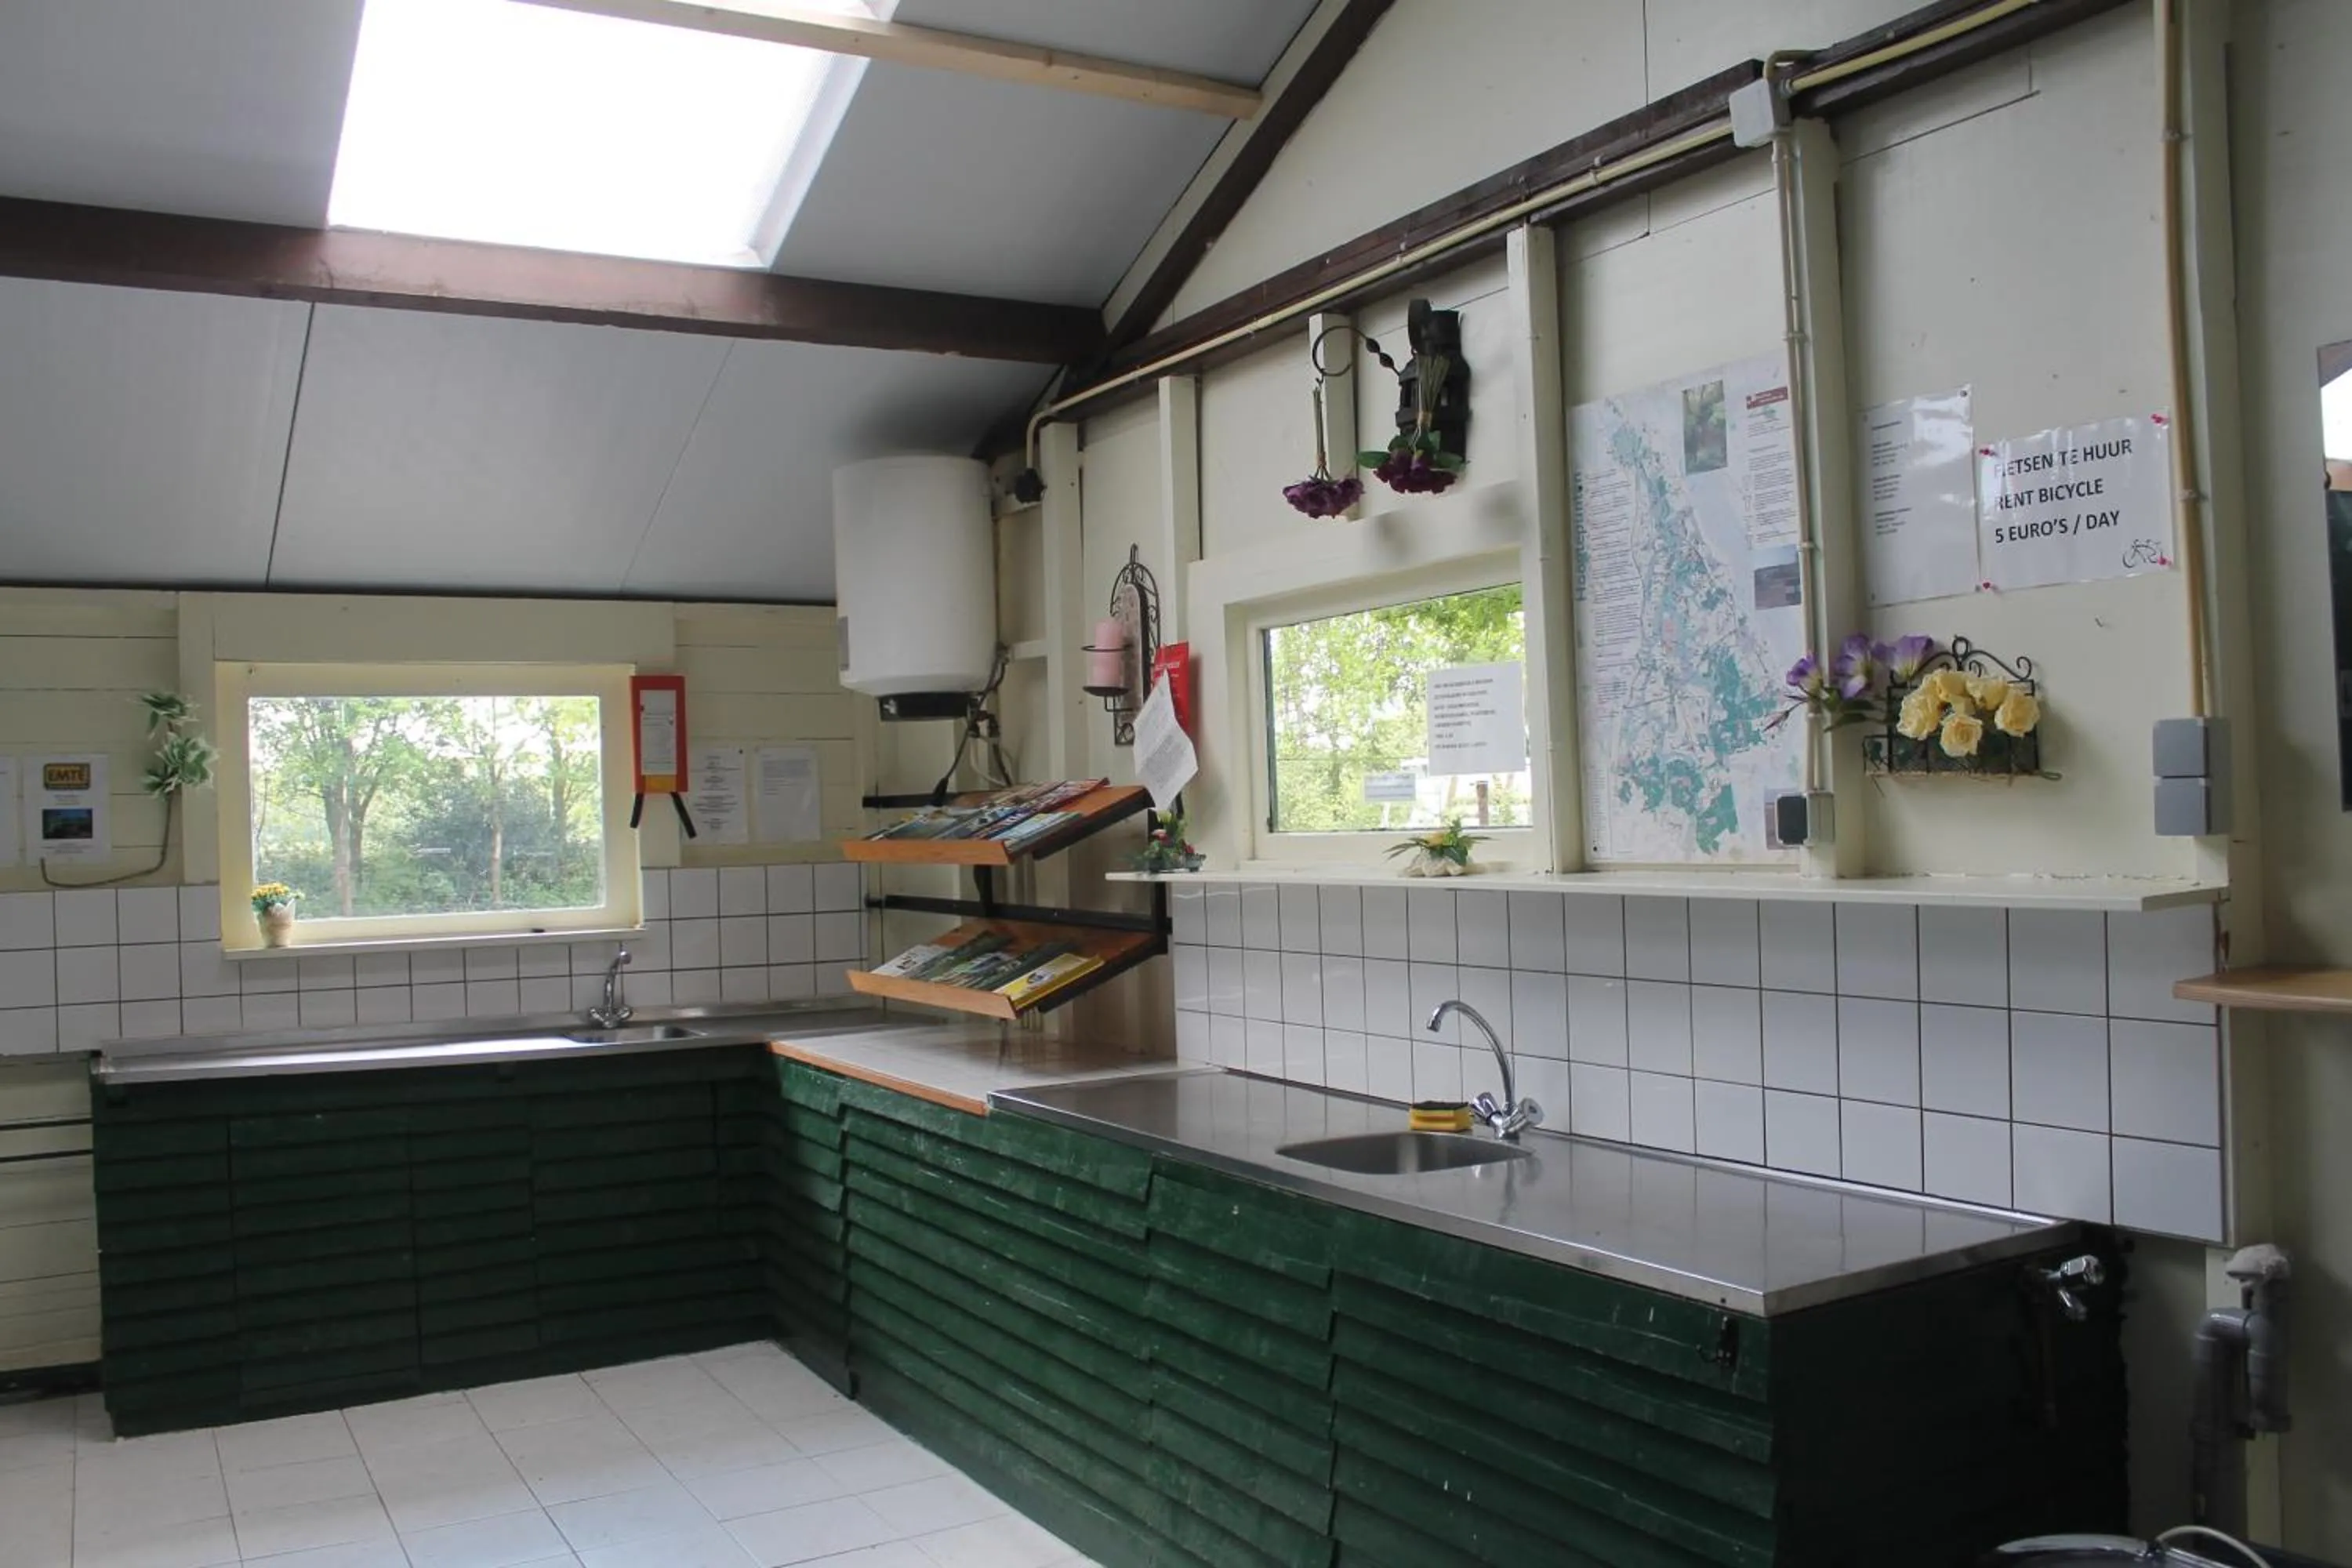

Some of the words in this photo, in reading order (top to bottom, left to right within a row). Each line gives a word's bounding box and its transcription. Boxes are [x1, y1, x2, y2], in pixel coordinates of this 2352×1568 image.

[2059, 449, 2078, 466] TE
[2083, 438, 2132, 462] HUUR
[1994, 490, 2034, 511] RENT
[2039, 478, 2103, 503] BICYCLE
[1995, 528, 2004, 543] 5
[2009, 517, 2068, 541] EURO'S
[2073, 514, 2082, 535] /
[2086, 510, 2121, 529] DAY
